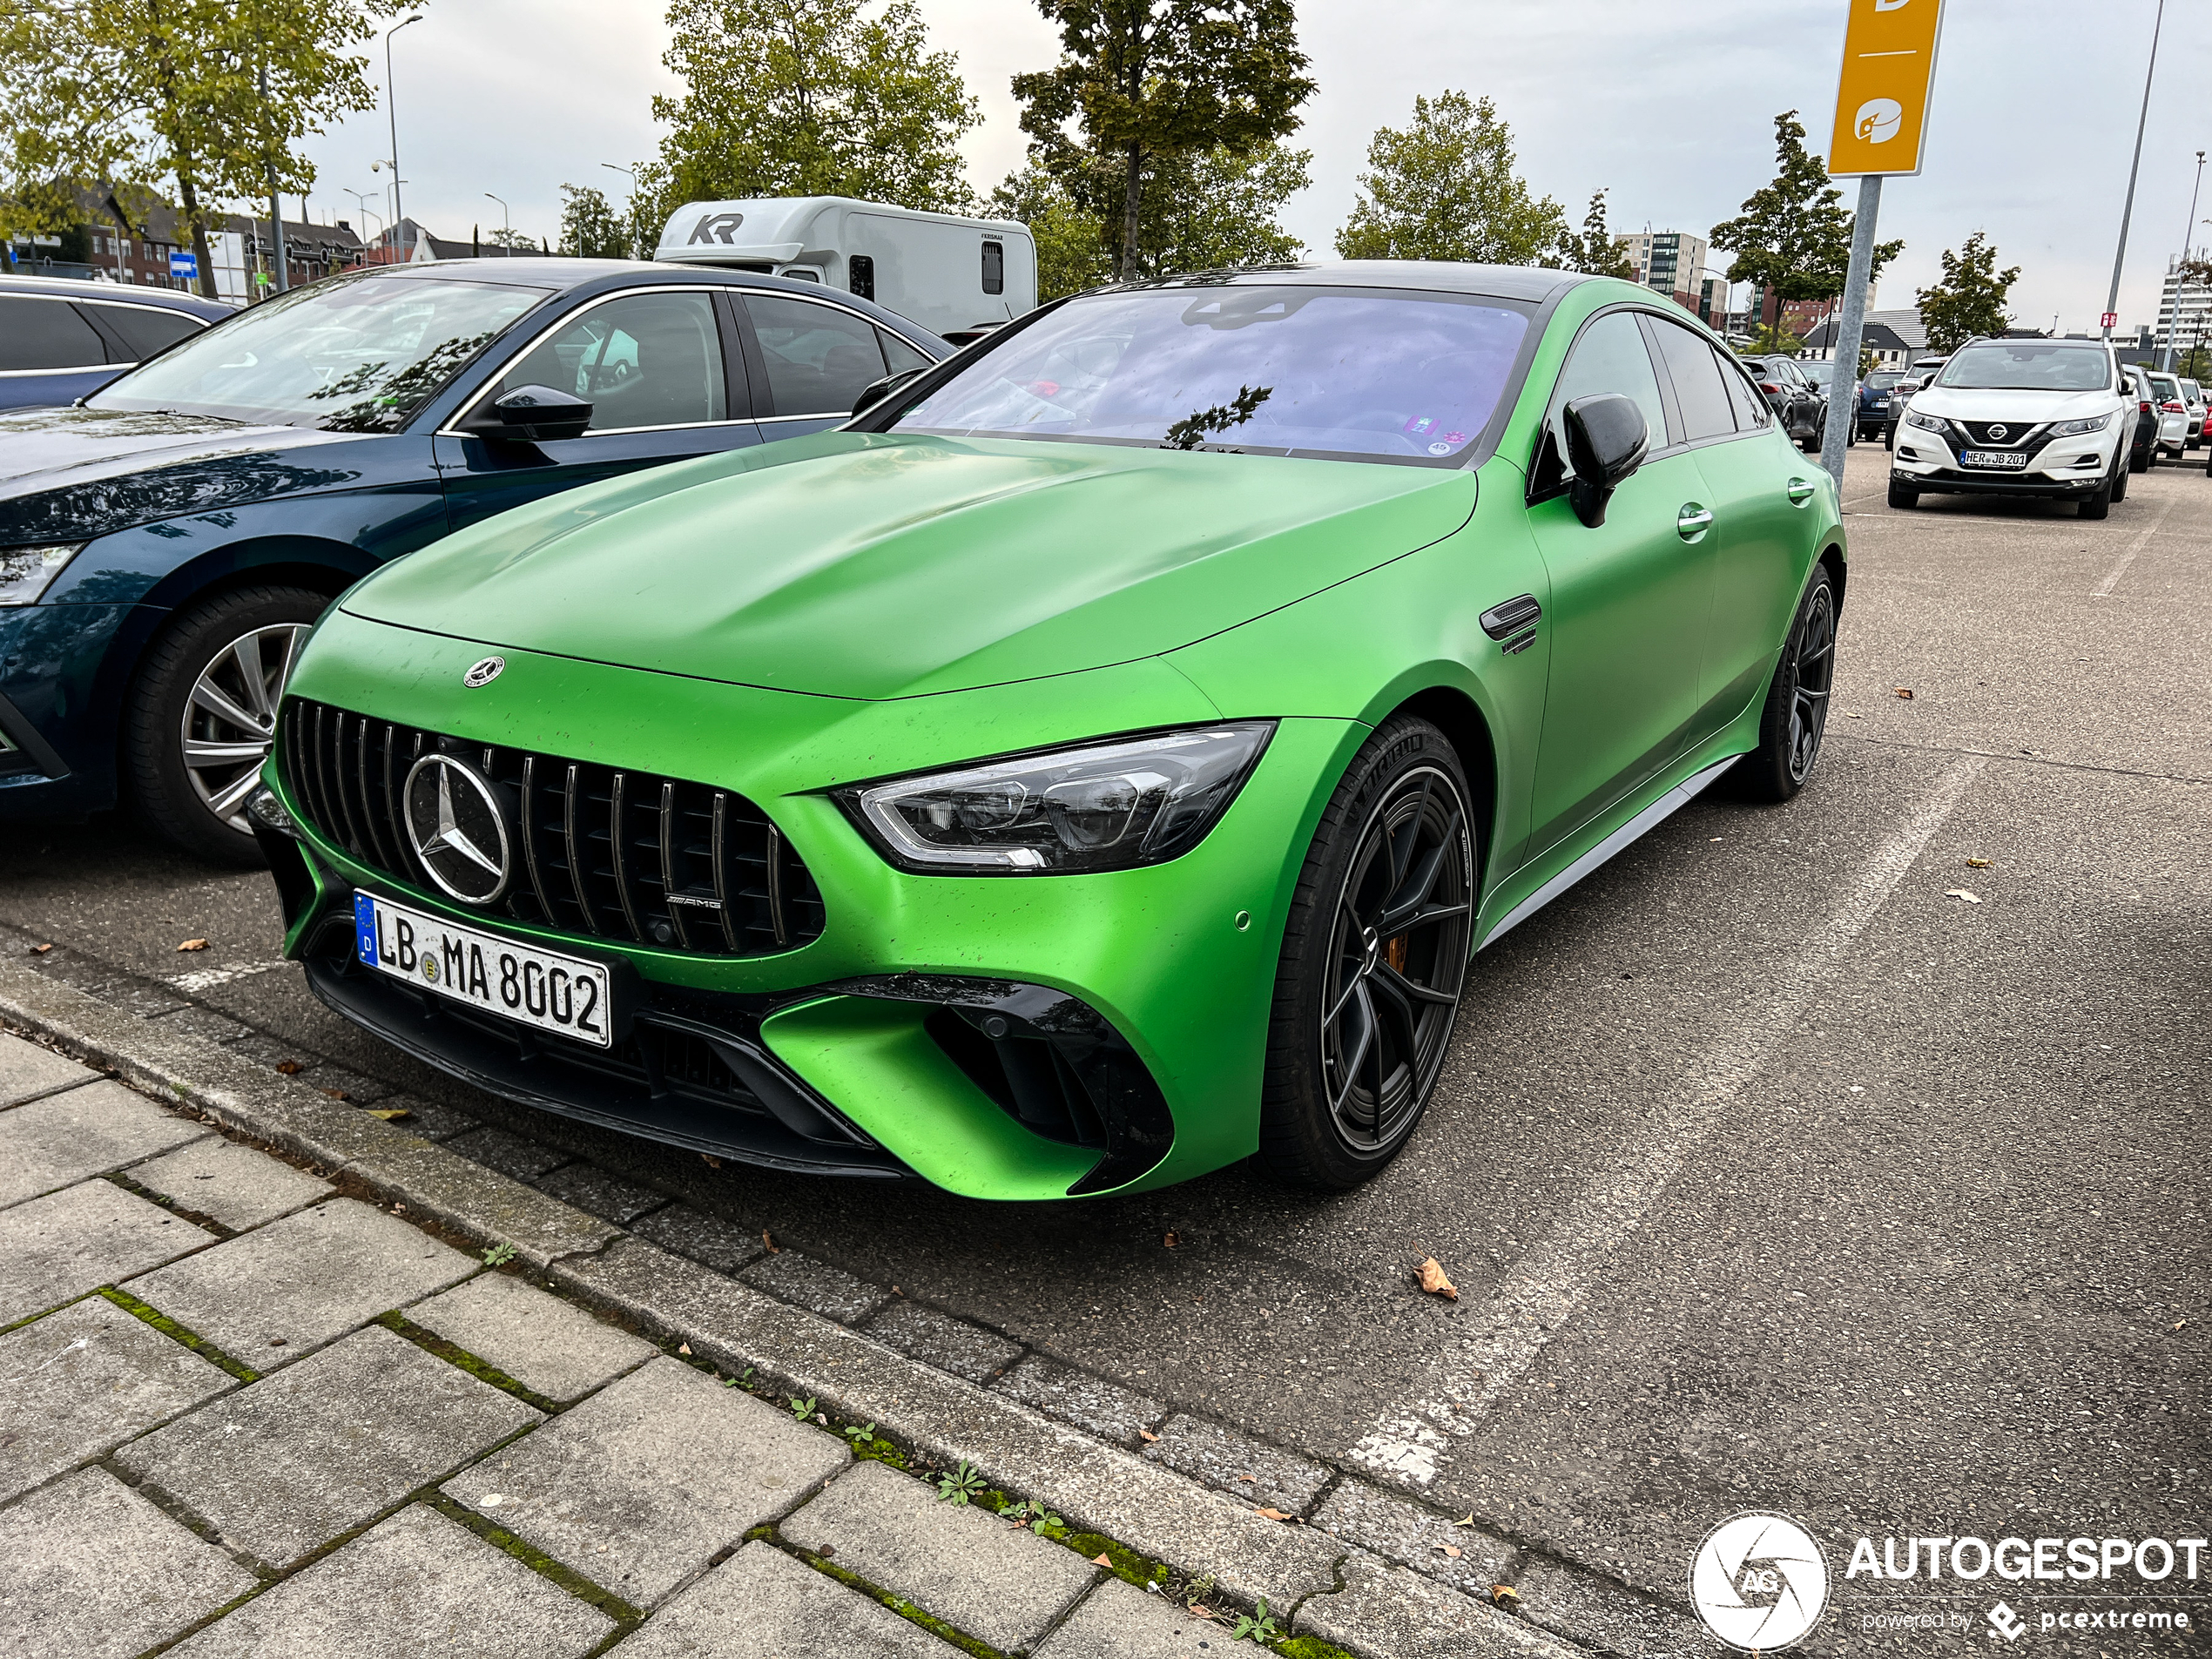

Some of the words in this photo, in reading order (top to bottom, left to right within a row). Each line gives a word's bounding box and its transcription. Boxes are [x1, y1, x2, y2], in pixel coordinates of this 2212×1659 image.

[687, 213, 744, 246] KR
[1411, 424, 1428, 433] 22
[1966, 453, 1986, 462] HER
[1992, 454, 2005, 464] JB
[2006, 455, 2025, 465] 201
[1362, 735, 1421, 799] MICHELIN
[684, 898, 721, 909] AMG
[364, 935, 372, 952] D
[376, 909, 417, 971] LB
[442, 934, 490, 1001] MA
[500, 953, 601, 1034] 8002
